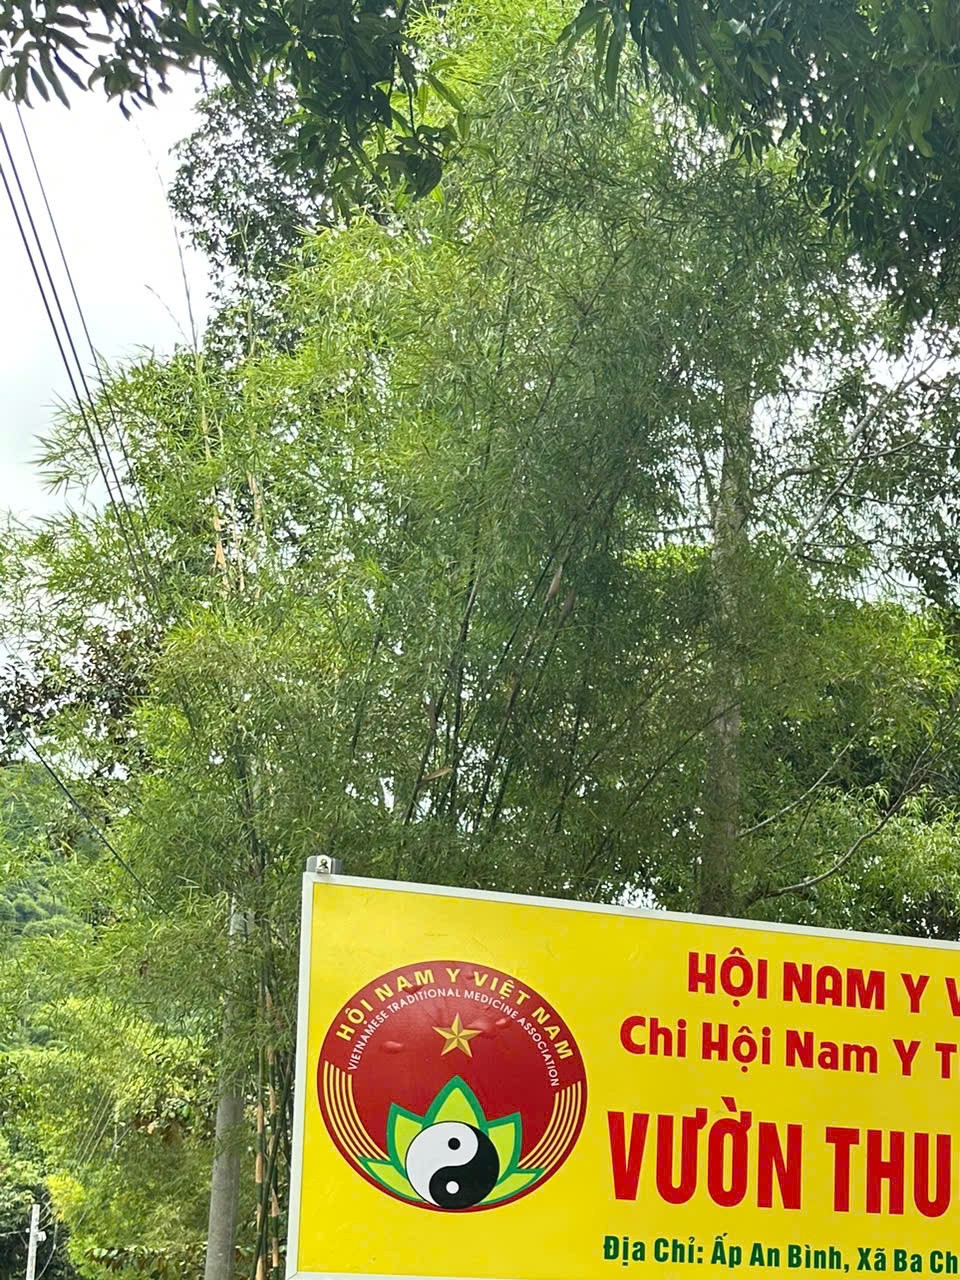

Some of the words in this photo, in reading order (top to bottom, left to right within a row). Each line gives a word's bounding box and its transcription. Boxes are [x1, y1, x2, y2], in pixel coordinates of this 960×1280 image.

[335, 999, 374, 1042] HỘI
[374, 968, 435, 1002] NAM
[445, 967, 460, 983] Y
[473, 970, 531, 1006] VIỆT
[531, 1006, 574, 1060] NAM
[688, 947, 768, 1007] HỘI
[783, 961, 886, 1011] NAM
[901, 973, 930, 1014] Y
[347, 1010, 390, 1072] VIETNAMESE
[386, 987, 461, 1014] TRADITIONAL
[464, 989, 519, 1019] MEDICINE
[516, 1017, 560, 1087] ASSOCIATION
[619, 1015, 687, 1058] Chi
[702, 1022, 772, 1073] Hội
[785, 1029, 878, 1074] Nam
[892, 1038, 922, 1077] Y
[607, 1096, 803, 1212] VƯỜN
[603, 1235, 646, 1266] Địa
[654, 1236, 704, 1264] Chỉ:
[711, 1233, 742, 1268] Ấp
[750, 1243, 780, 1267] An
[788, 1244, 850, 1273] Bình,
[857, 1247, 887, 1272] Xã
[893, 1249, 923, 1273] Ba
